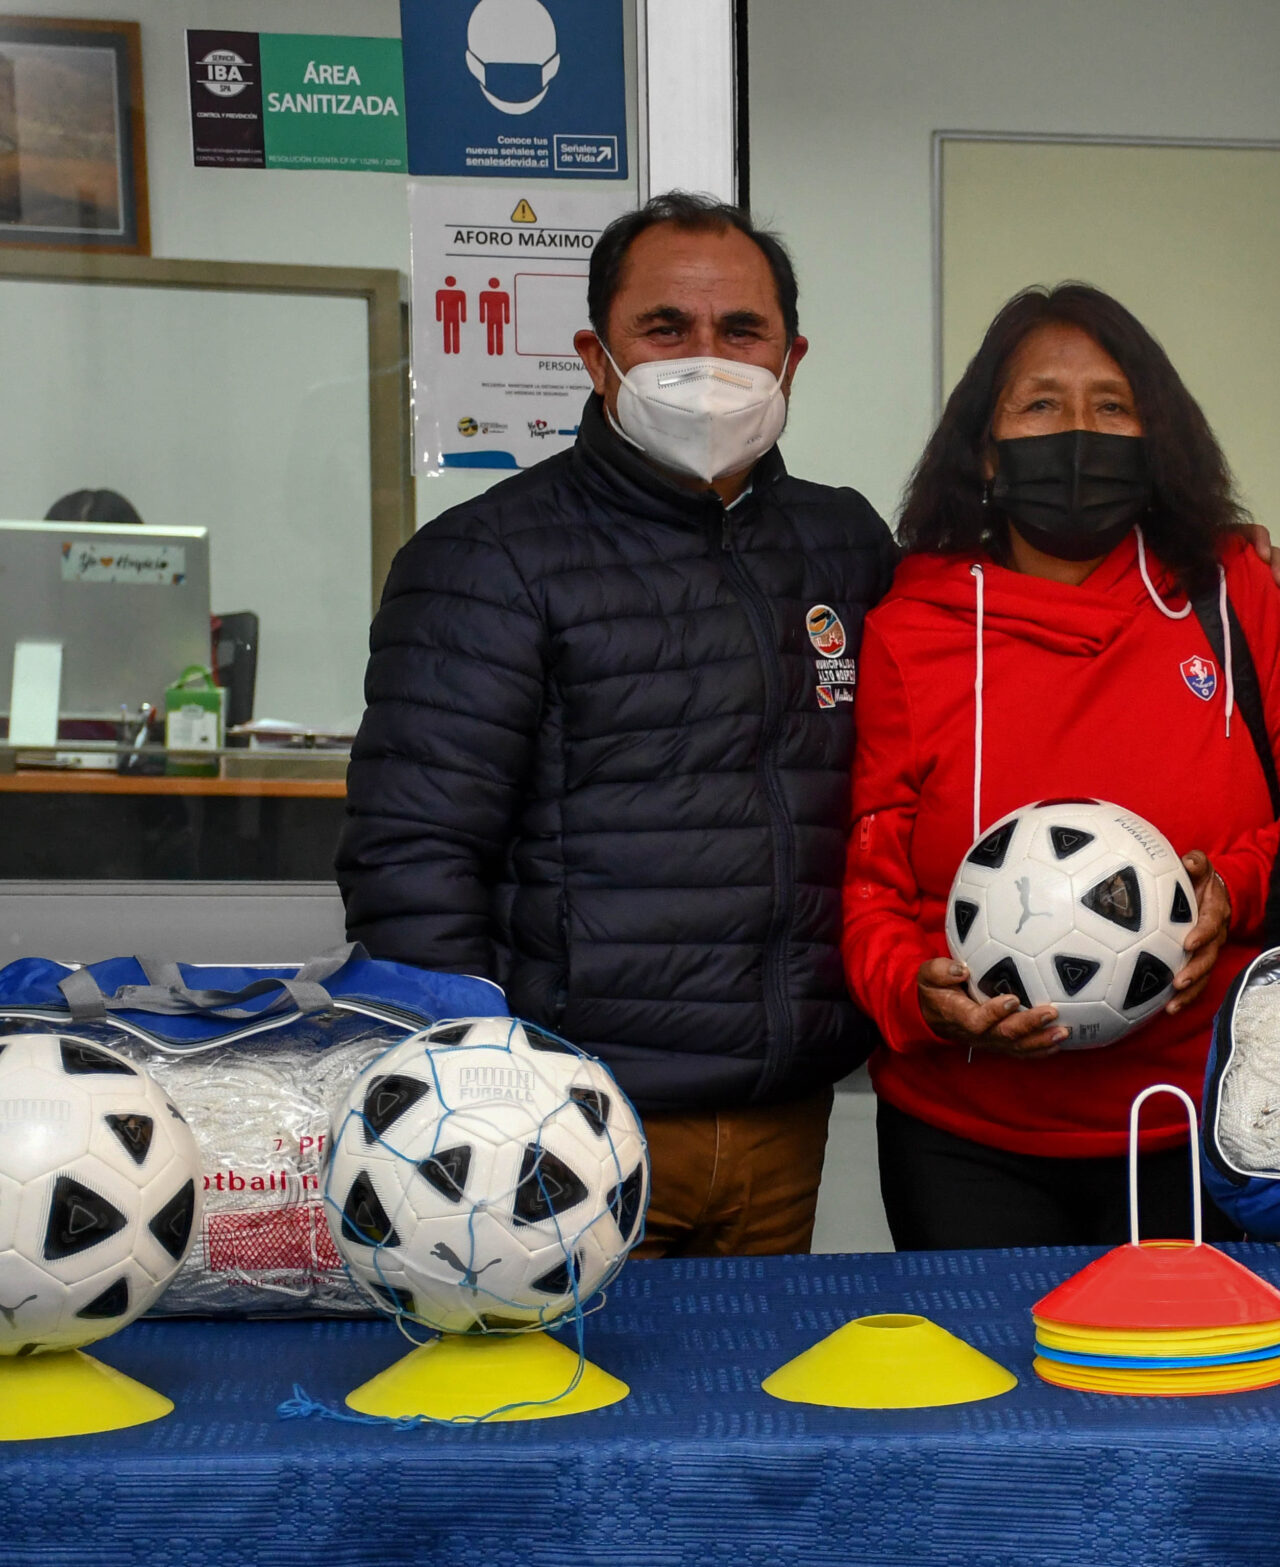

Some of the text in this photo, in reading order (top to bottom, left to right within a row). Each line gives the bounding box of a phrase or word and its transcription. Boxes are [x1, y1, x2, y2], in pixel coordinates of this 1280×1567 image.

[207, 65, 243, 82] IBA
[303, 60, 361, 86] ÁREA
[219, 84, 232, 93] SPA
[267, 92, 399, 117] SANITIZADA
[497, 135, 549, 145] Conoce tus
[465, 146, 499, 155] nuevas
[500, 146, 536, 157] señales
[560, 143, 597, 154] Señales
[465, 156, 549, 168] senalesdevida.cl
[560, 154, 596, 163] de Vida
[453, 228, 595, 249] AFORO MÁXIMO
[817, 670, 836, 682] ALTO
[273, 1138, 284, 1152] 7
[227, 1278, 265, 1287] MADE
[295, 1276, 336, 1286] CHINA
